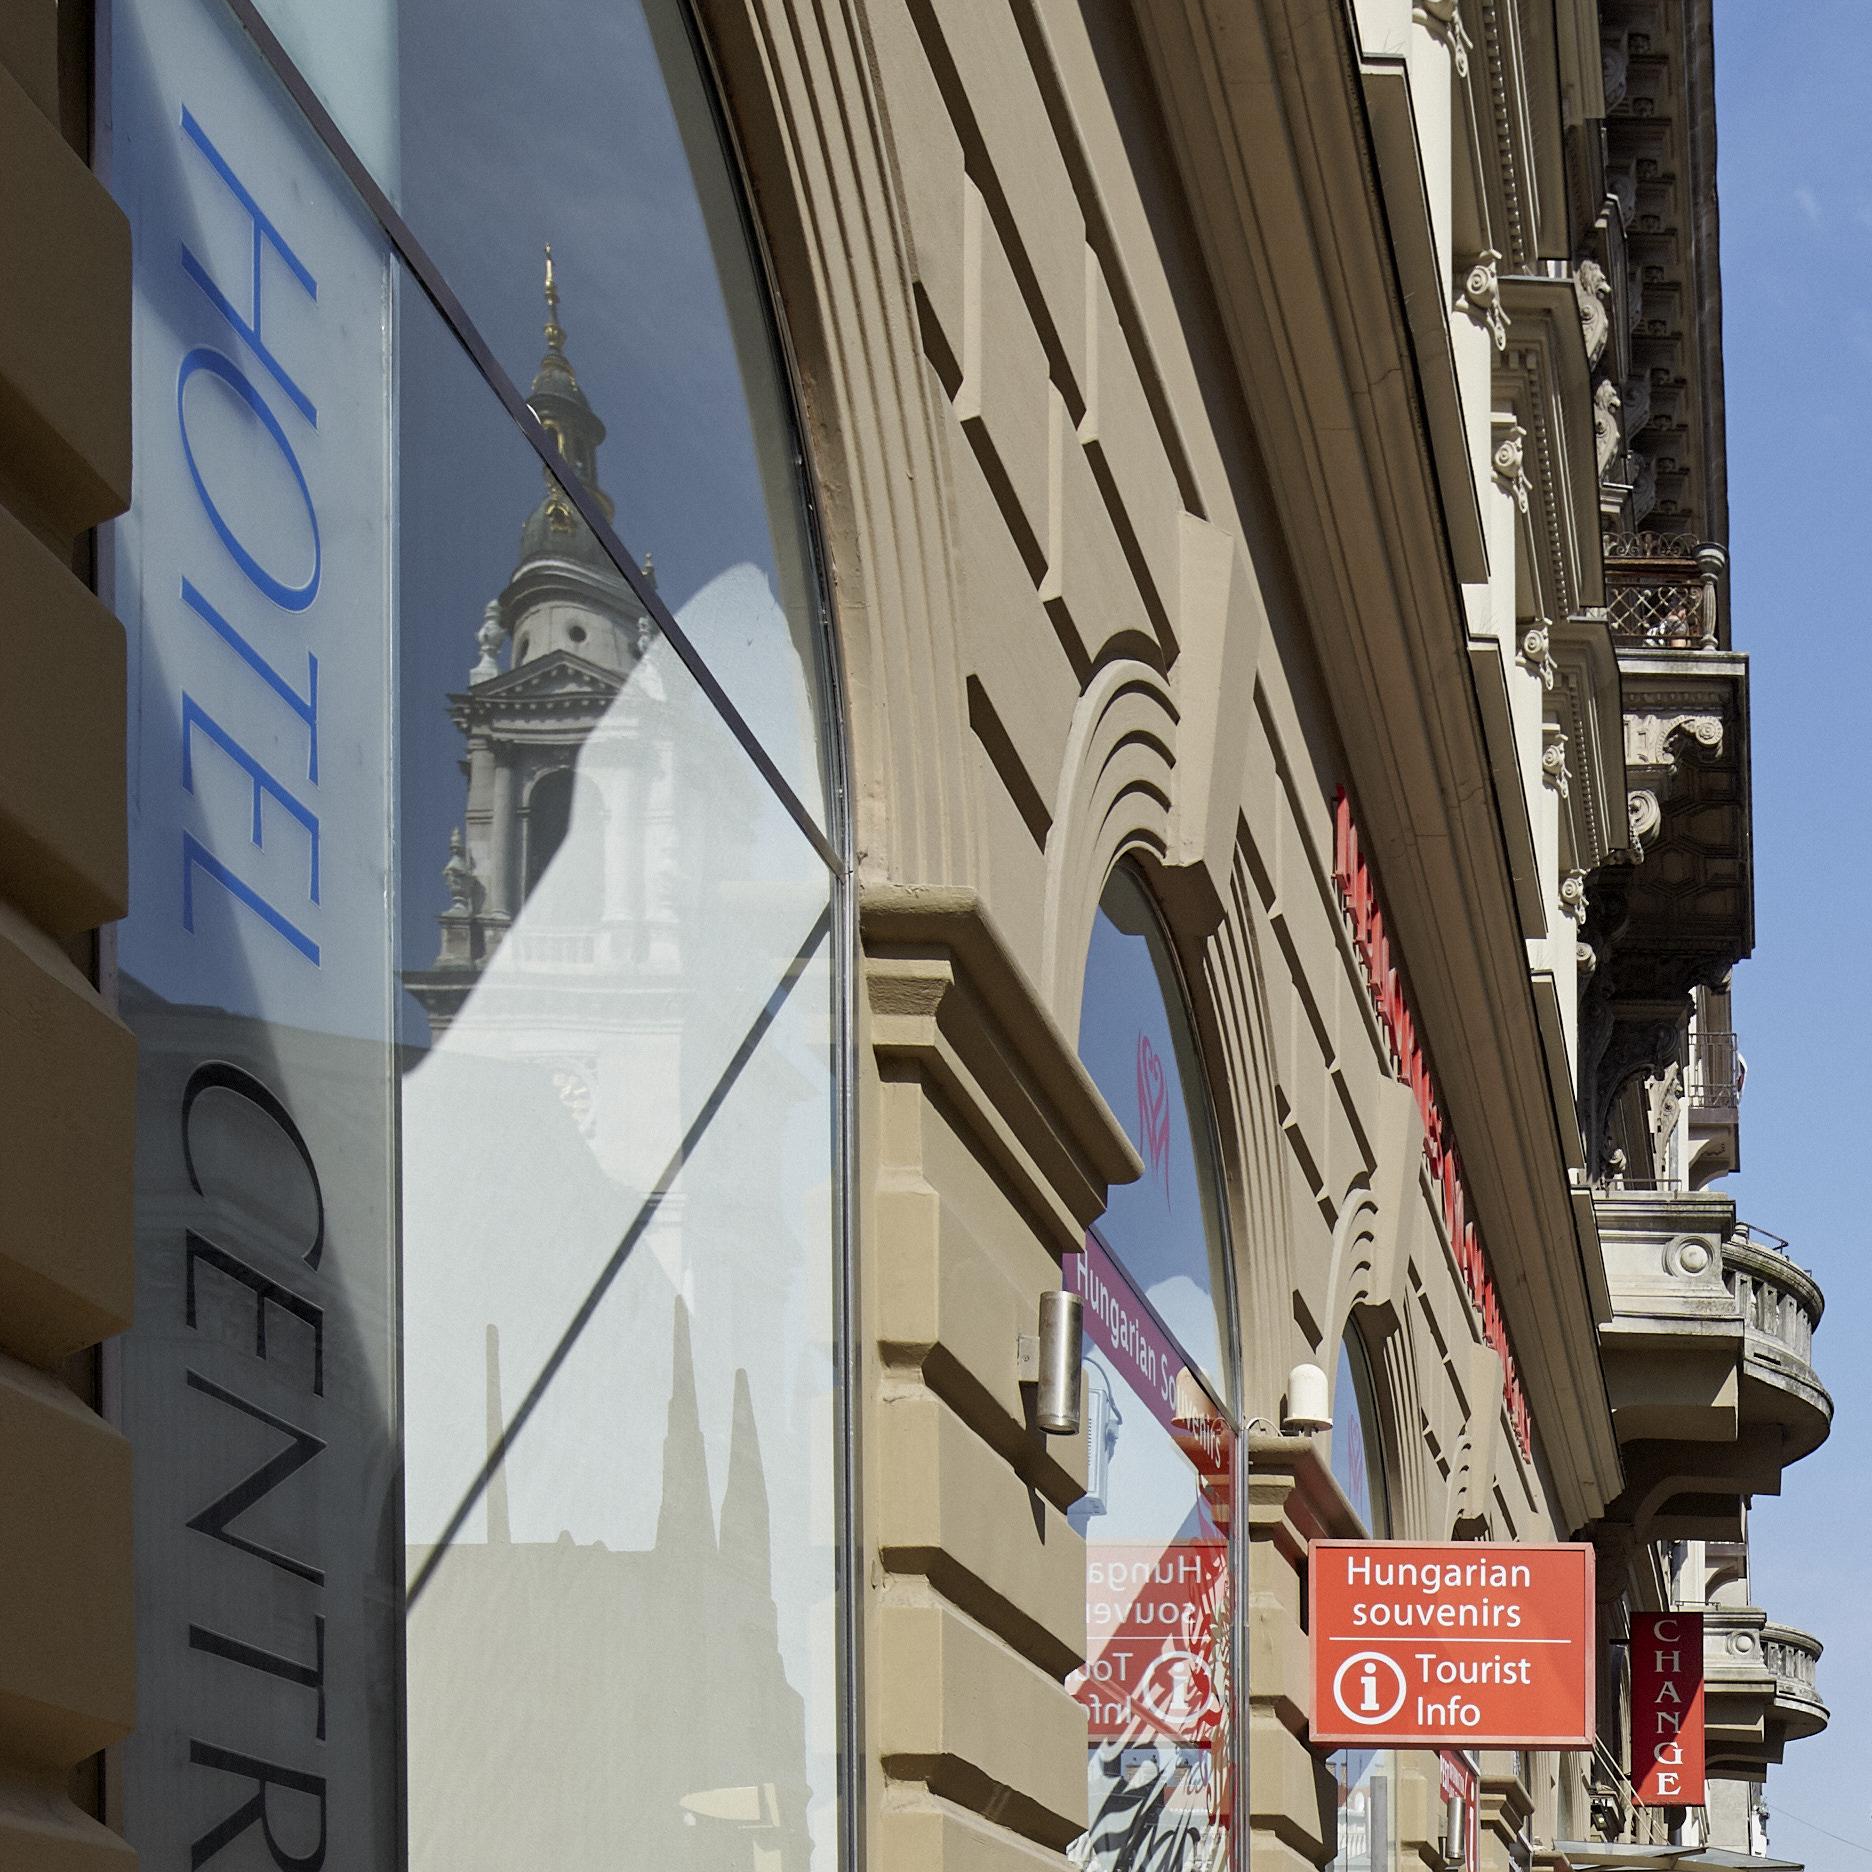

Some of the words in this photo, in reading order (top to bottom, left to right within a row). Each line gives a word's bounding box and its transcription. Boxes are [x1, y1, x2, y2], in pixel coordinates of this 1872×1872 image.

[179, 104, 320, 969] HOTEL
[1076, 1250, 1157, 1382] Hungarian
[1161, 1358, 1221, 1469] Souvenirs
[1347, 1556, 1531, 1594] Hungarian
[1353, 1598, 1521, 1627] souvenirs
[1415, 1653, 1531, 1685] Tourist
[1417, 1695, 1481, 1726] Info
[1653, 1620, 1684, 1795] CHANGE
